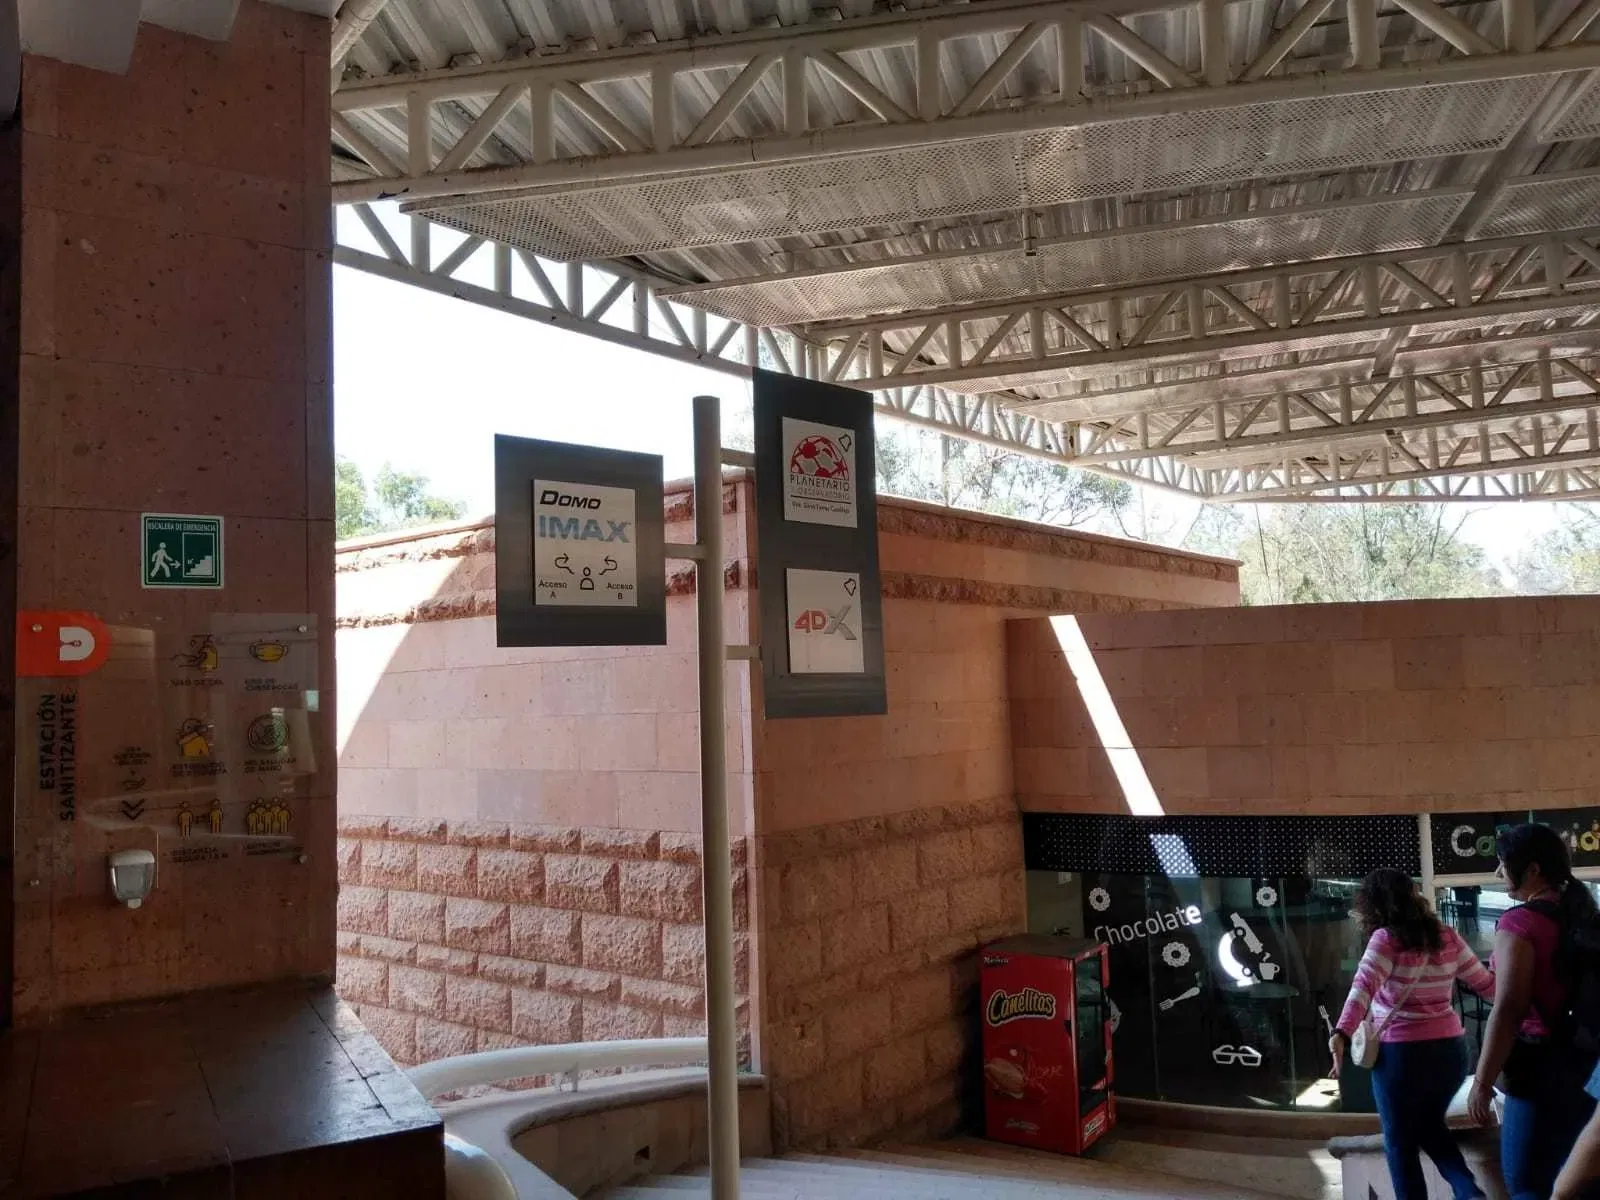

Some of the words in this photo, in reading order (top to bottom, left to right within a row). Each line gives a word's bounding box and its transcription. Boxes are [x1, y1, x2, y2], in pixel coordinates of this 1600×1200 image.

[790, 474, 850, 491] PLANETARIO
[540, 490, 602, 509] DOMO
[175, 522, 182, 532] DE
[539, 515, 631, 543] IMAX
[538, 580, 567, 589] Acceso
[606, 582, 633, 590] Acceso
[793, 605, 857, 640] 4DX
[37, 693, 56, 790] ESTACIÓN
[60, 689, 76, 821] SANITIZANTE
[1094, 904, 1203, 945] Chocolate
[988, 988, 1055, 1023] Canelitas
